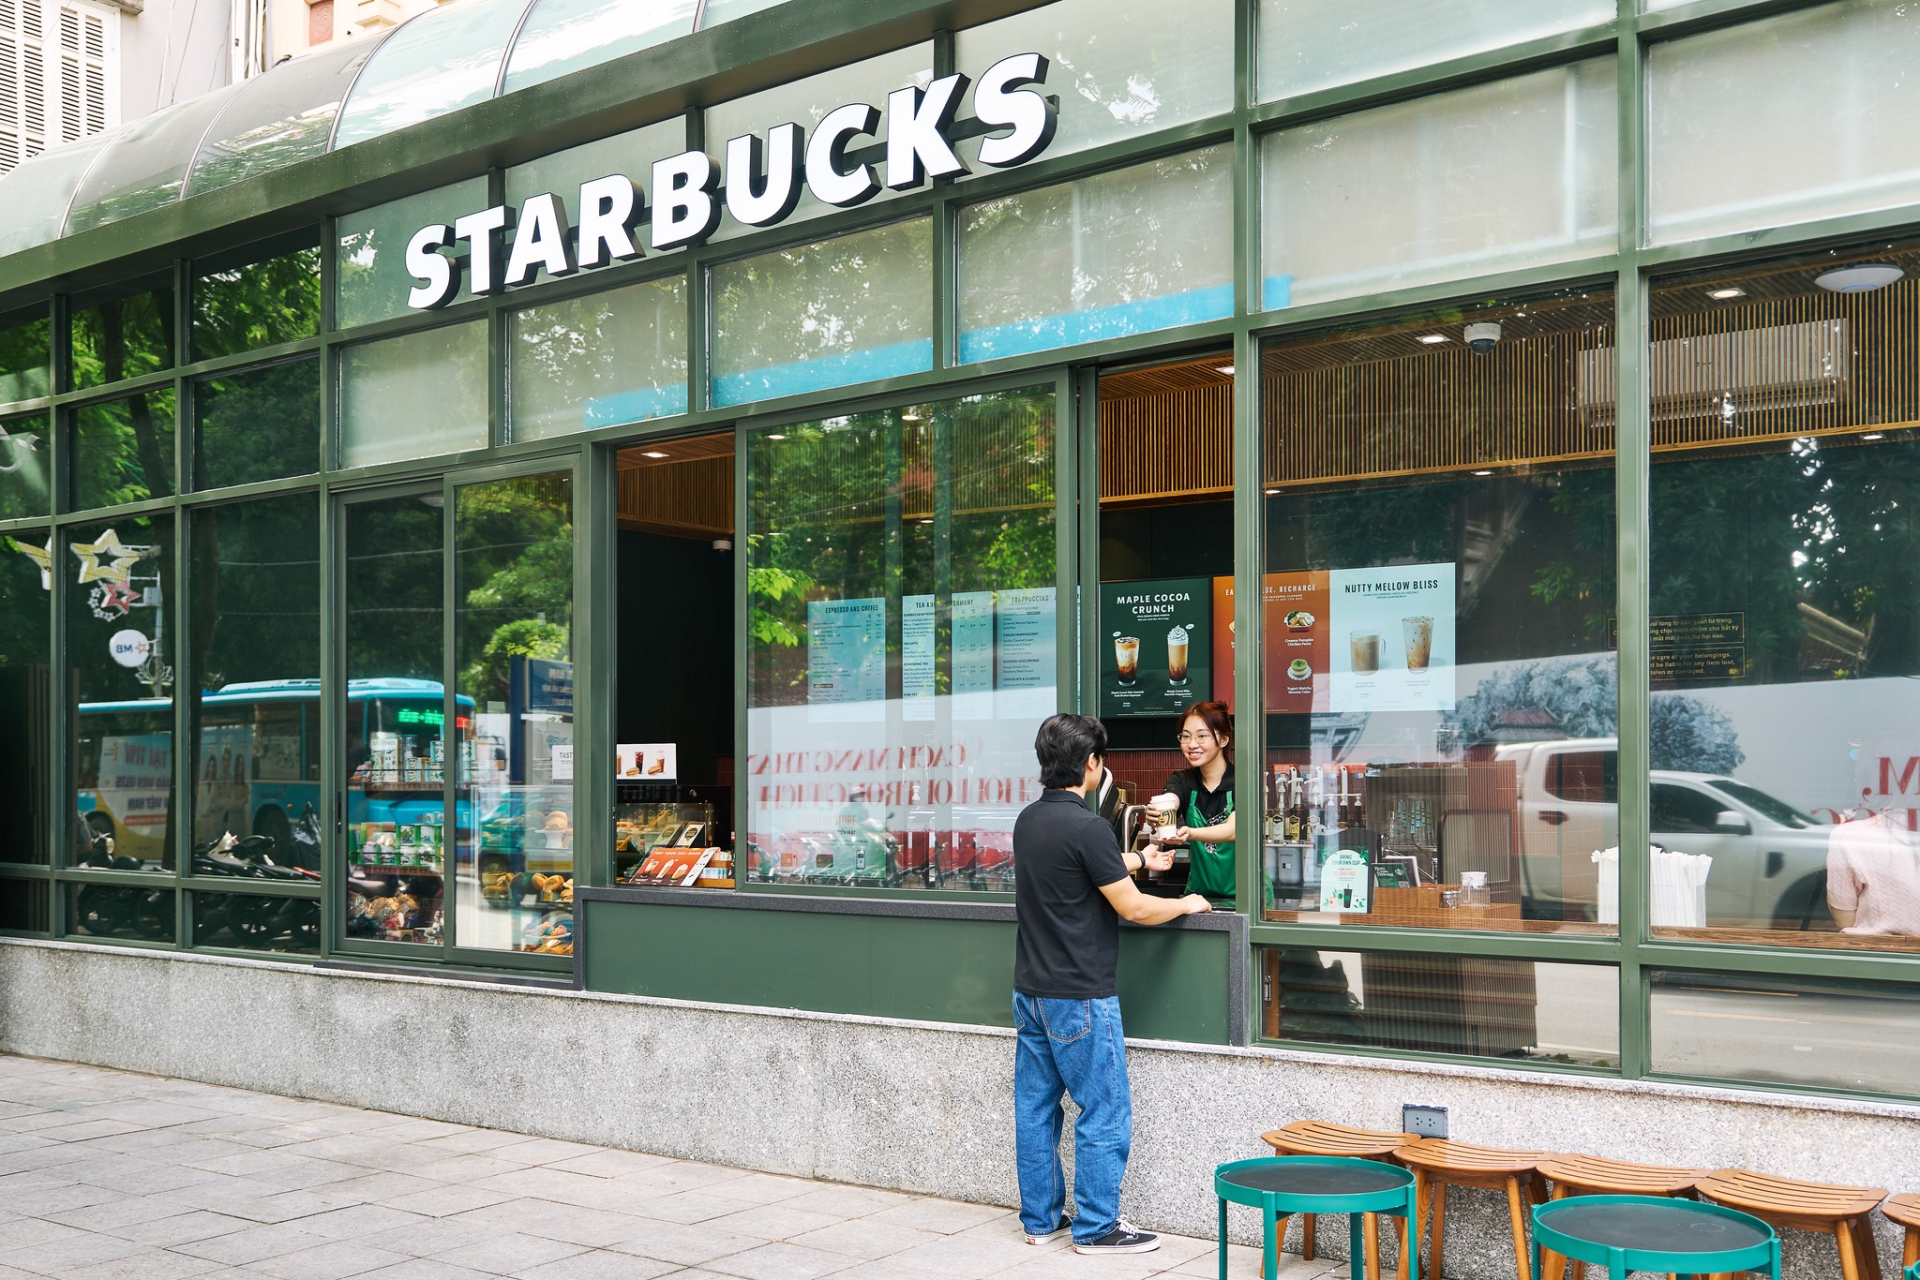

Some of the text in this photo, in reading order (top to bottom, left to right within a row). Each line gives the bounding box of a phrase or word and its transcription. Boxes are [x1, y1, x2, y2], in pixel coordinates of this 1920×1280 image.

[405, 52, 1055, 310] STARBUCKS
[1344, 580, 1438, 593] NUTTY MELLOW BLISS
[1116, 593, 1190, 604] MAPLE COCOA
[1132, 605, 1174, 614] CRUNCH
[834, 815, 856, 825] STORE
